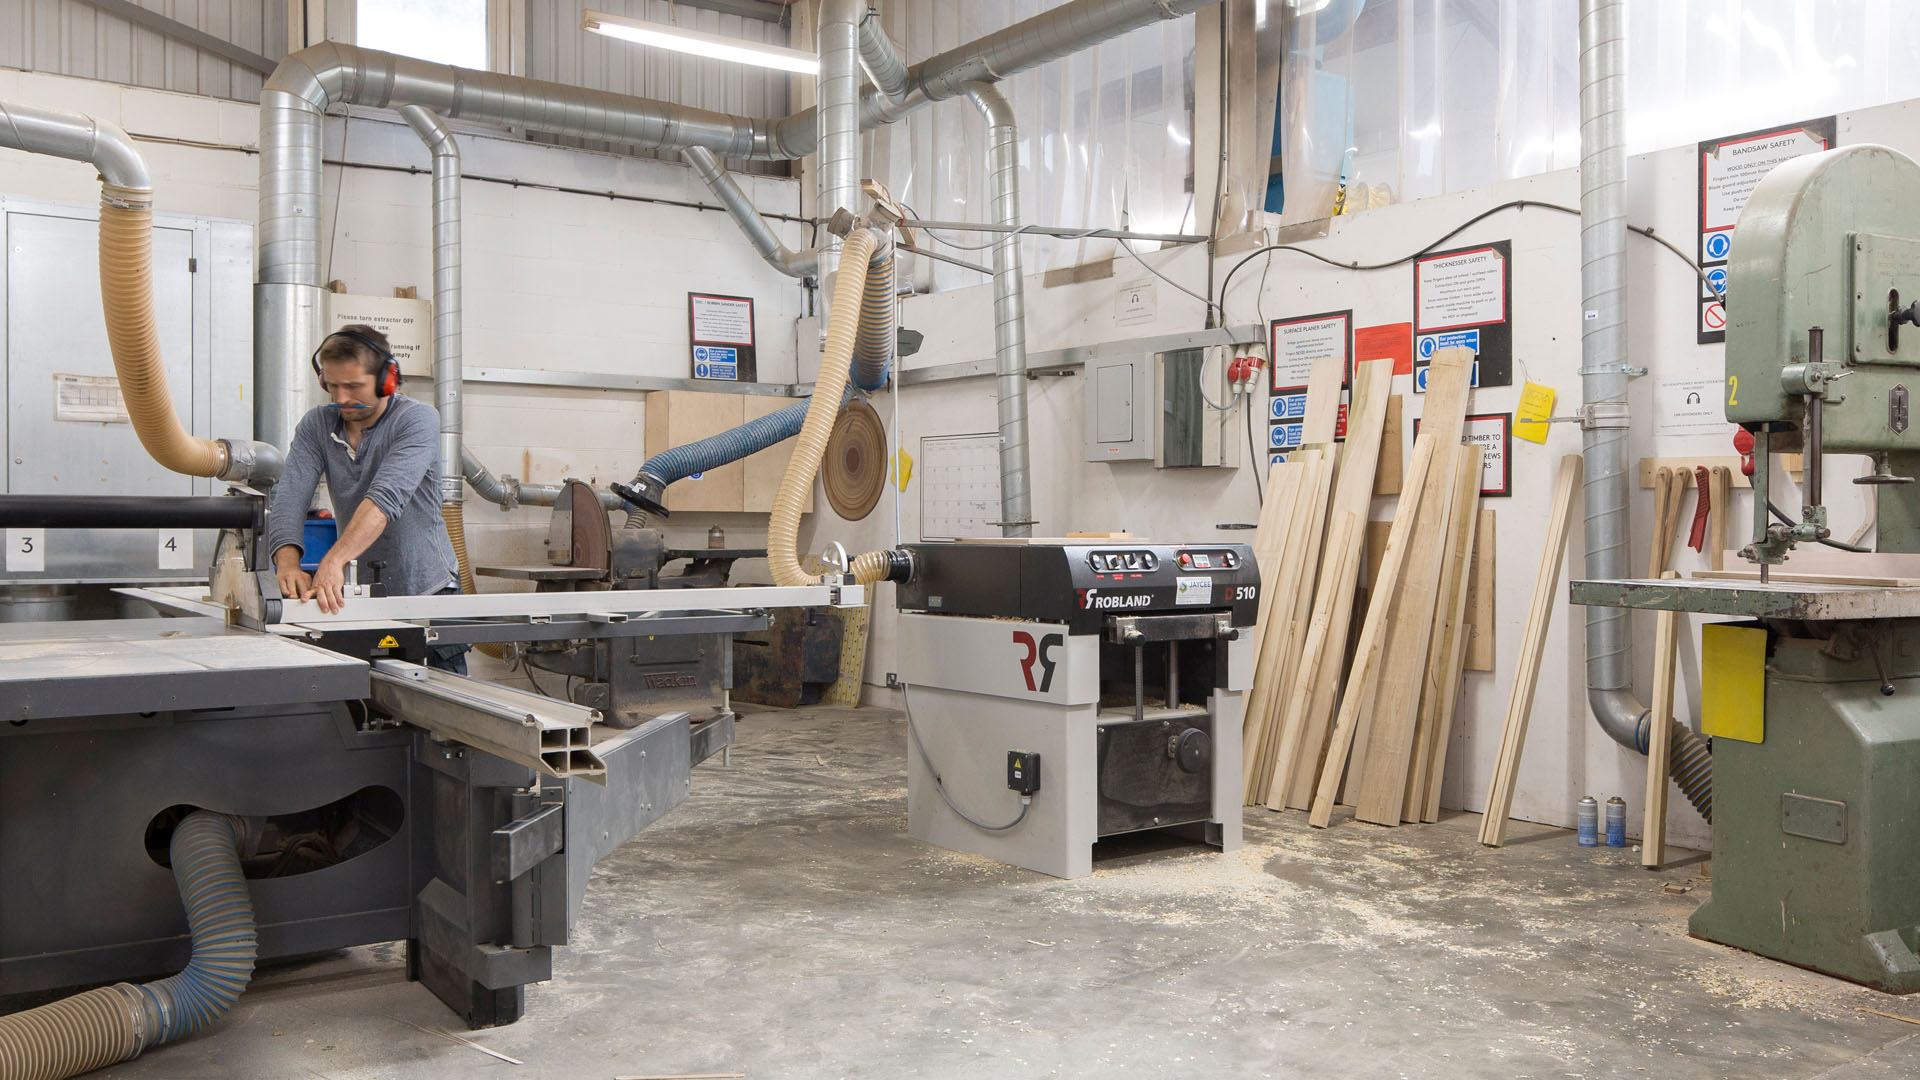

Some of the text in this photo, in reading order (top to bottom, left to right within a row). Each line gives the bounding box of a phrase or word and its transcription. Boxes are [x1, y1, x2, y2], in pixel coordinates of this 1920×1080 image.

[1732, 138, 1796, 156] BANDSAW SAFETY
[1433, 256, 1487, 269] THICKNESSER SAFETY
[1728, 376, 1738, 406] 2
[21, 536, 33, 554] 3
[164, 536, 177, 552] 4
[1225, 587, 1234, 600] D
[1236, 586, 1256, 600] 510
[1095, 595, 1151, 609] ROBLAND
